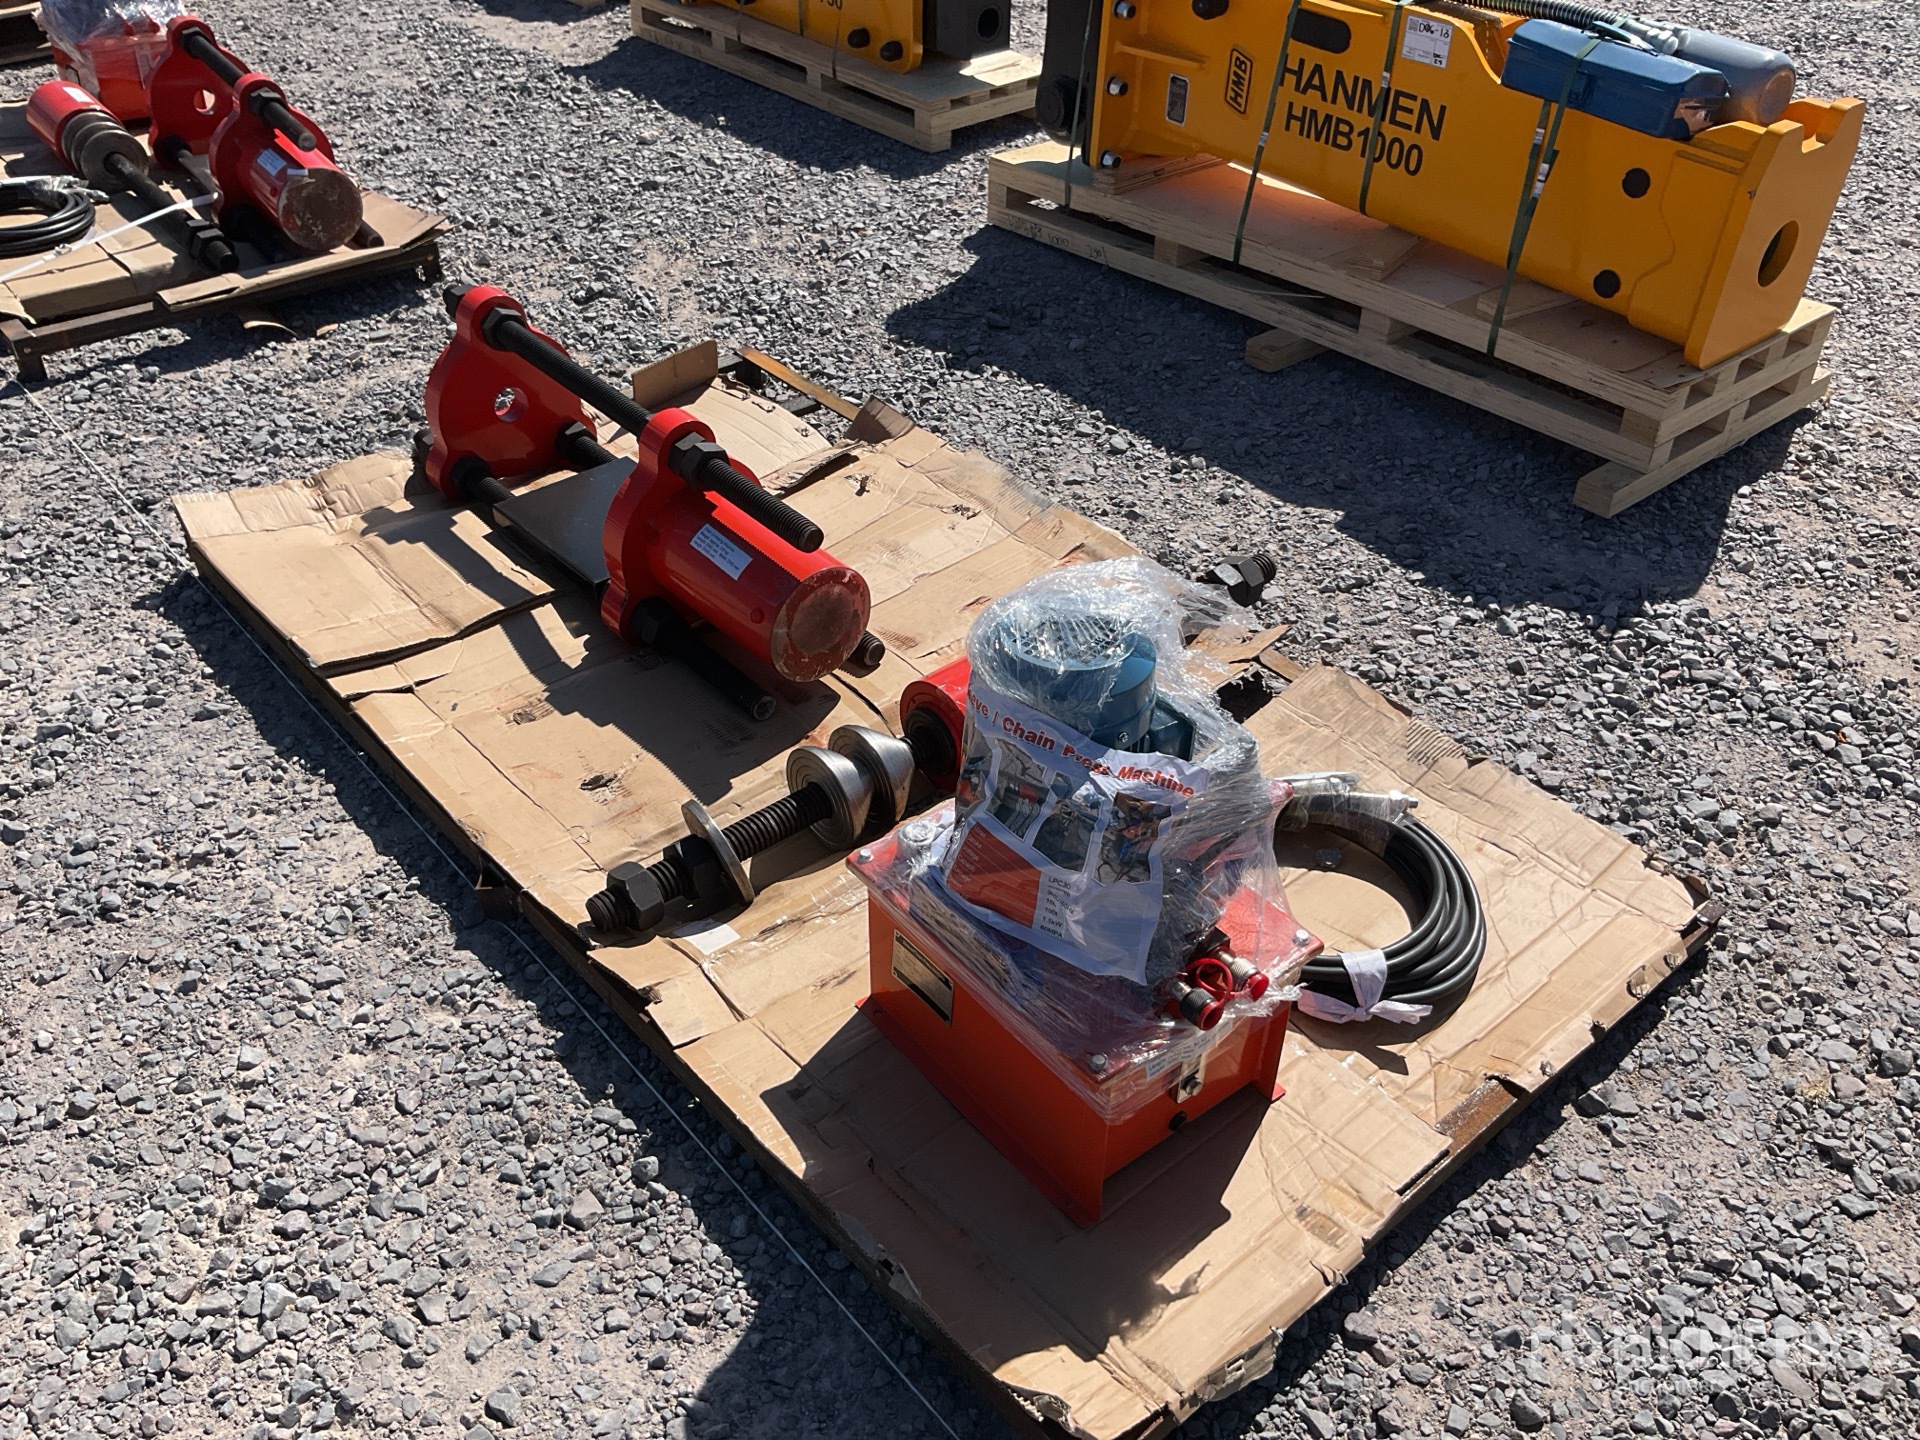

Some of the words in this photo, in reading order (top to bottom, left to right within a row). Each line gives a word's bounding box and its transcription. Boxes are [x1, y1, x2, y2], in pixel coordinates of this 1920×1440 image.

[1229, 56, 1248, 108] HMB
[1279, 53, 1447, 142] HANMEN
[1285, 101, 1424, 177] HMB1000
[1002, 716, 1056, 751] Chain
[1062, 743, 1111, 775] Press
[1117, 766, 1195, 797] Machine
[1048, 876, 1072, 890] LPC30
